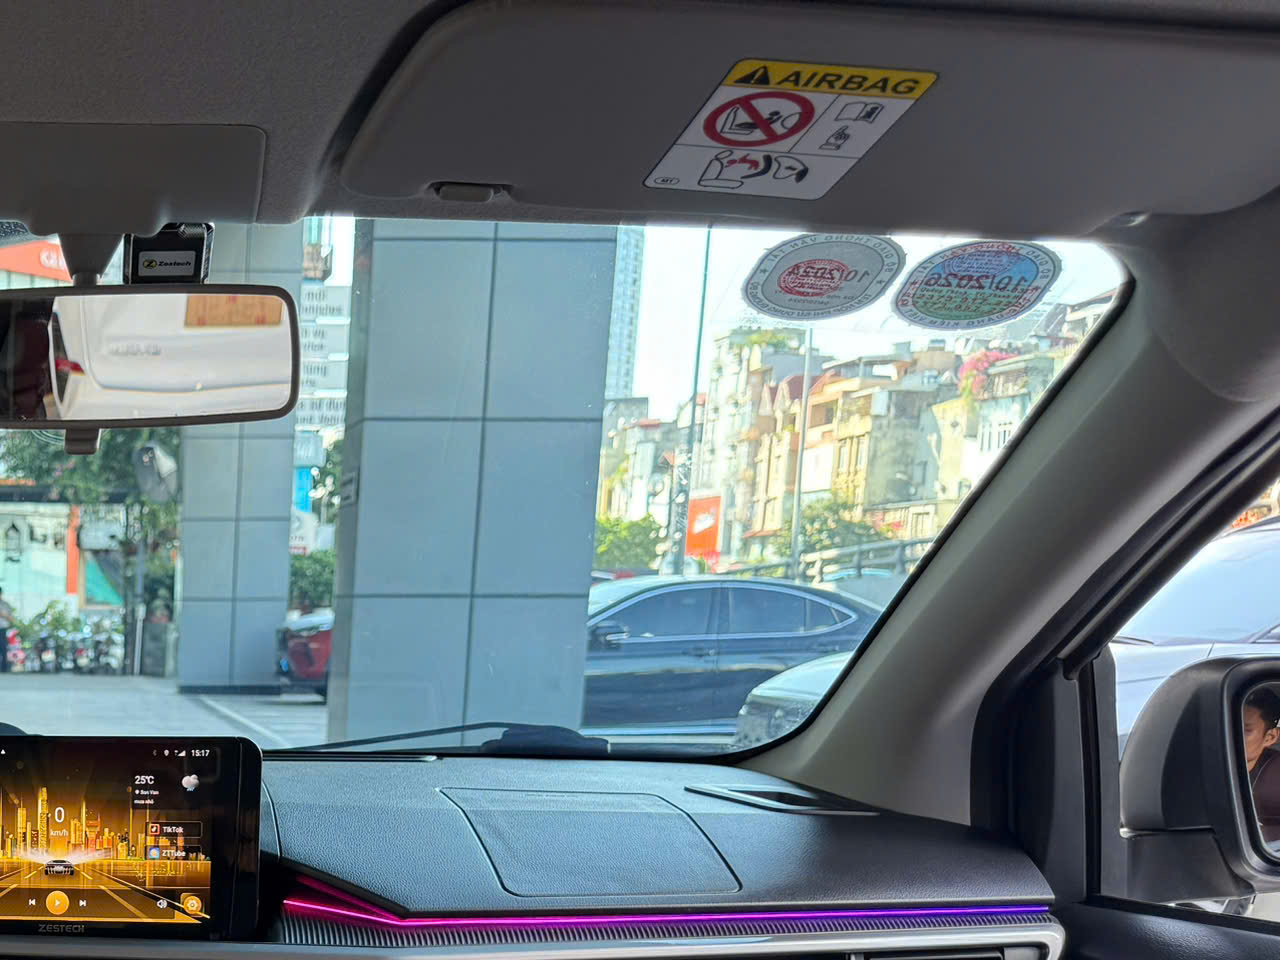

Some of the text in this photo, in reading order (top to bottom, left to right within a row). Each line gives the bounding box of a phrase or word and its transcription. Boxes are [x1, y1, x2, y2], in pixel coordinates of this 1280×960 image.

[776, 70, 921, 95] AIRBAG
[191, 749, 210, 757] 15:17
[54, 806, 65, 823] 0
[49, 828, 69, 837] km/h
[38, 924, 85, 933] ZESTECH
